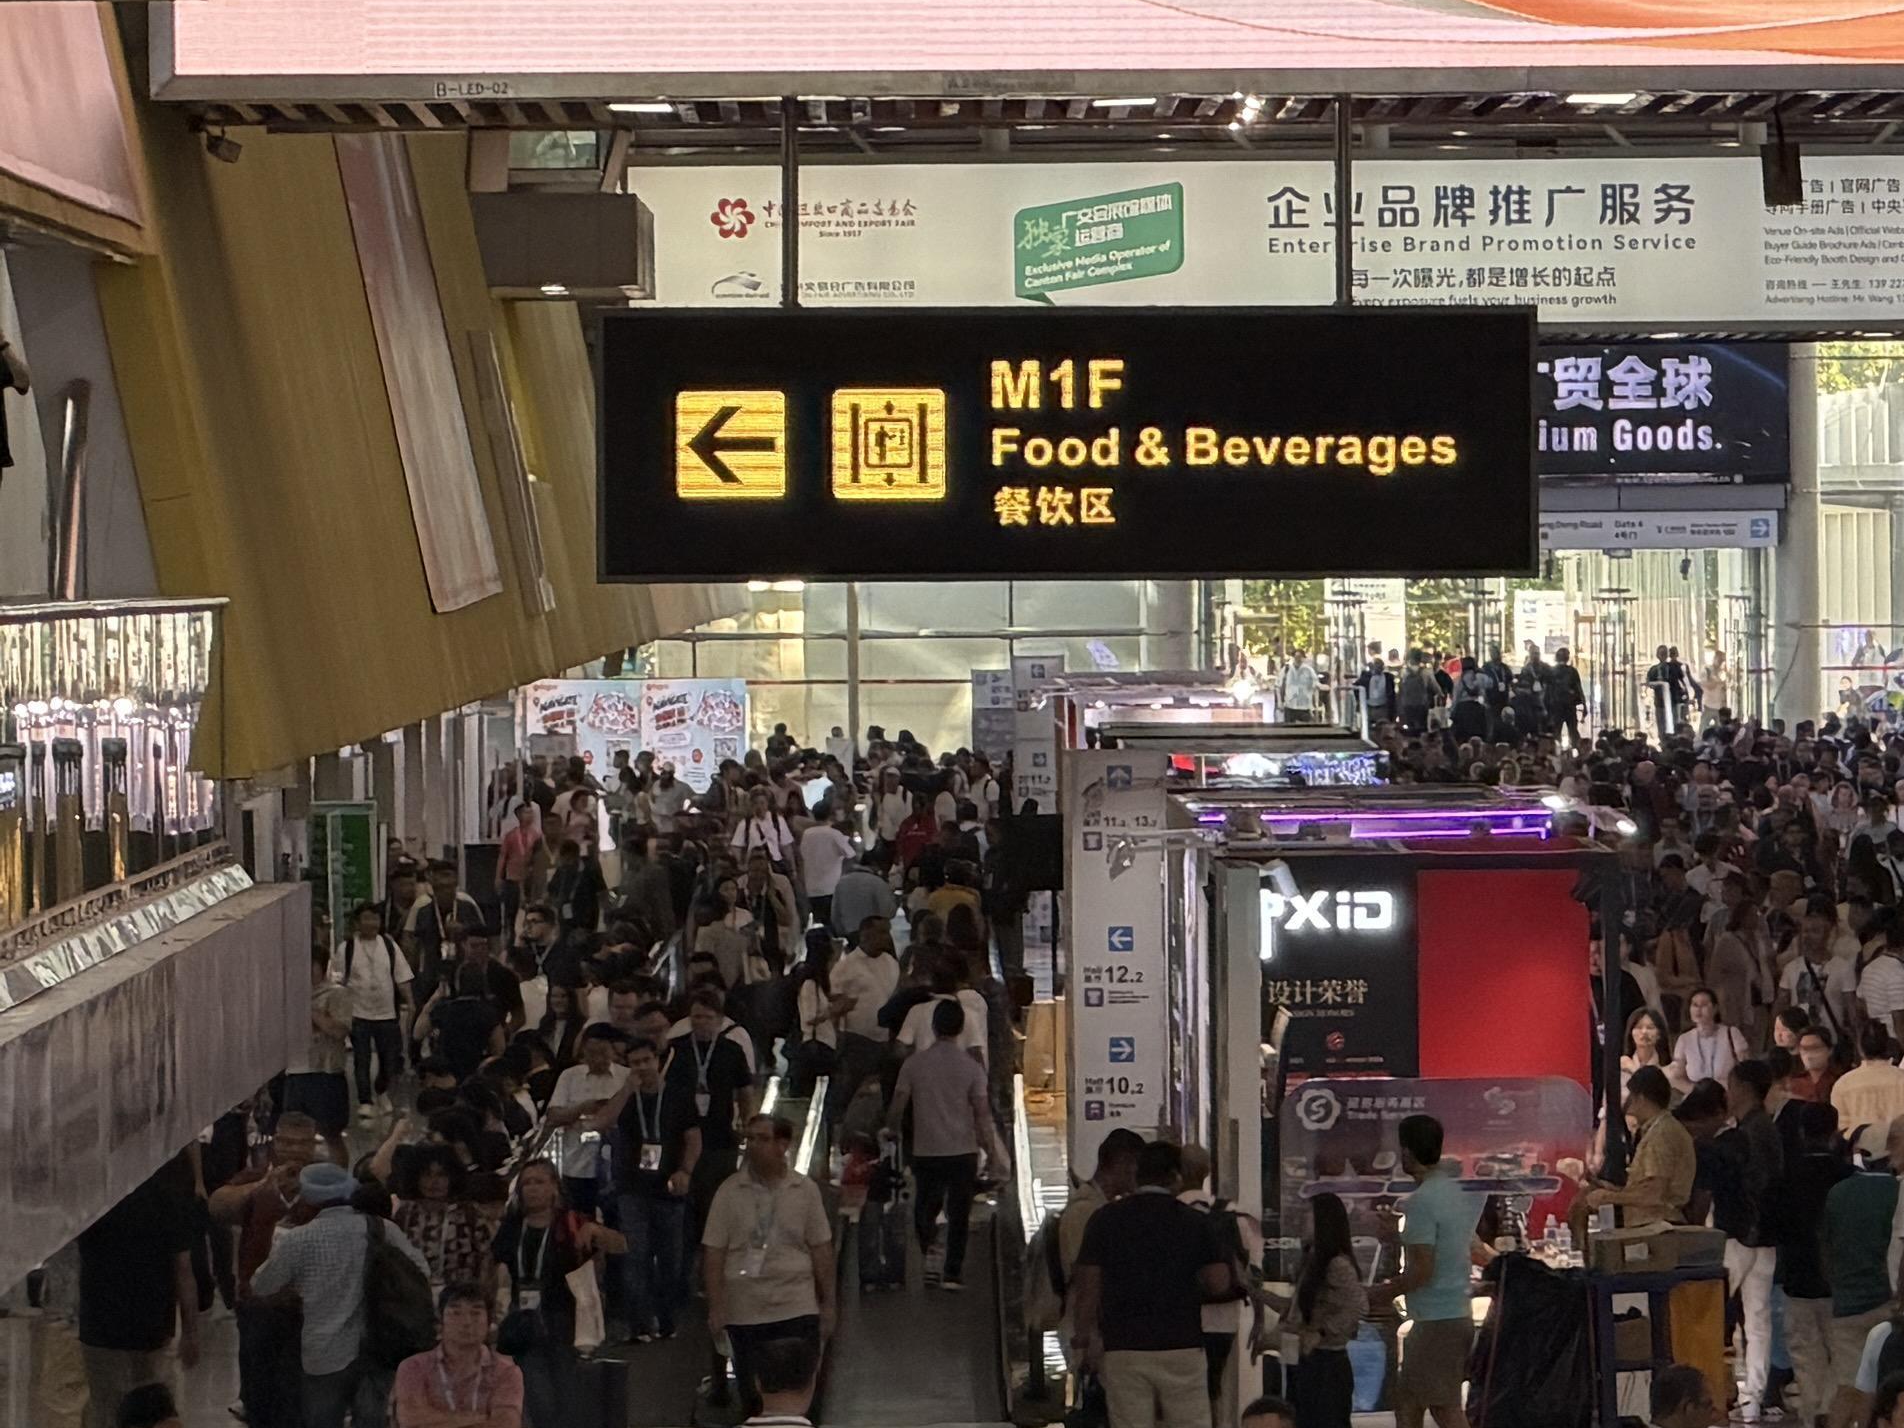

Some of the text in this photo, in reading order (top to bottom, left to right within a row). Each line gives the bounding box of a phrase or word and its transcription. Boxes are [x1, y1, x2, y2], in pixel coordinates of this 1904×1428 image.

[1840, 177, 1900, 193] 官网广告
[762, 198, 917, 218] 中出口商品交易会
[1267, 183, 1696, 228] 企业品牌推广服务
[801, 220, 831, 228] MPORT
[1268, 233, 1697, 254] Enterrise Brand Promotion Service
[1514, 295, 1568, 306] business
[1571, 295, 1617, 306] growth
[991, 361, 1125, 409] M1F
[1537, 355, 1714, 411] 贸全球
[1613, 418, 1723, 452] Goods.
[992, 427, 1459, 479] Food & Beverages
[993, 485, 1117, 526] 餐饮区
[1105, 966, 1144, 983] 12.2
[1267, 978, 1369, 1005] 设计荣誉
[1106, 1077, 1144, 1094] 10.2
